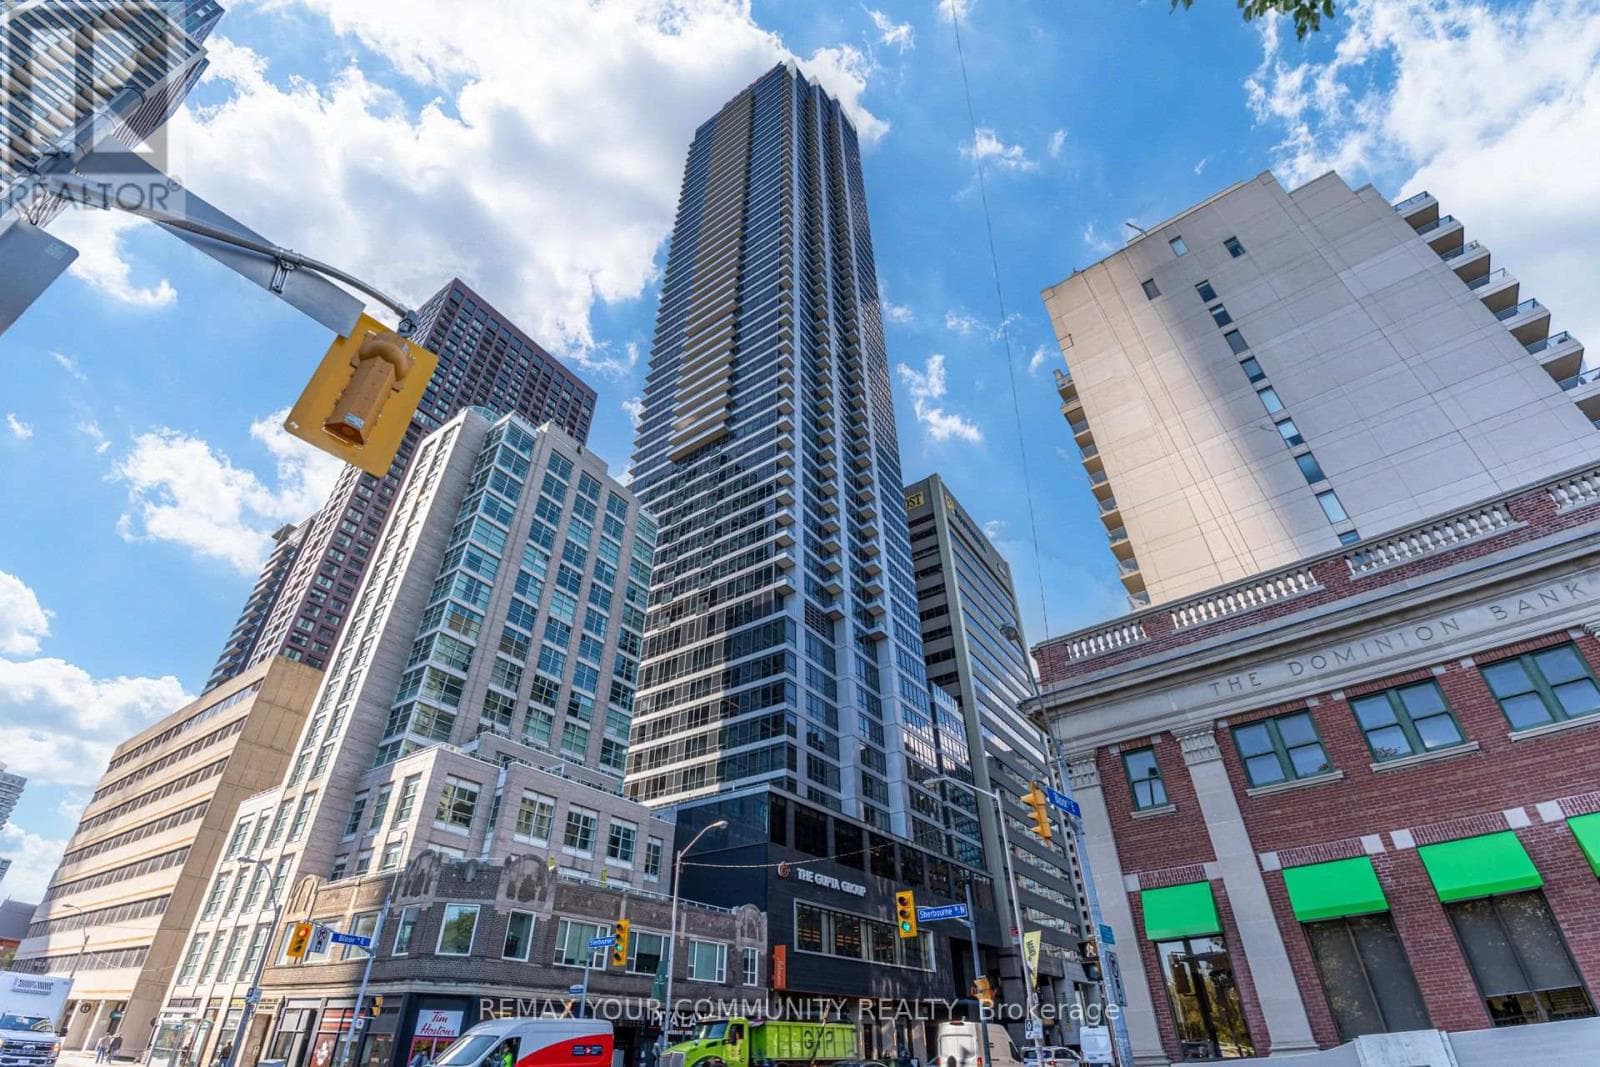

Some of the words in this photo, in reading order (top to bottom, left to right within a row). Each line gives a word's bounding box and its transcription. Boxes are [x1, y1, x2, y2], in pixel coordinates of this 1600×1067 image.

[1208, 671, 1262, 697] THE
[1288, 617, 1461, 677] DOMINION
[1488, 582, 1587, 621] BANK
[796, 867, 814, 883] THE
[814, 873, 841, 891] GUPTA
[919, 909, 953, 920] Sherbourne
[432, 1011, 448, 1023] Tim
[420, 1022, 455, 1035] Hortons
